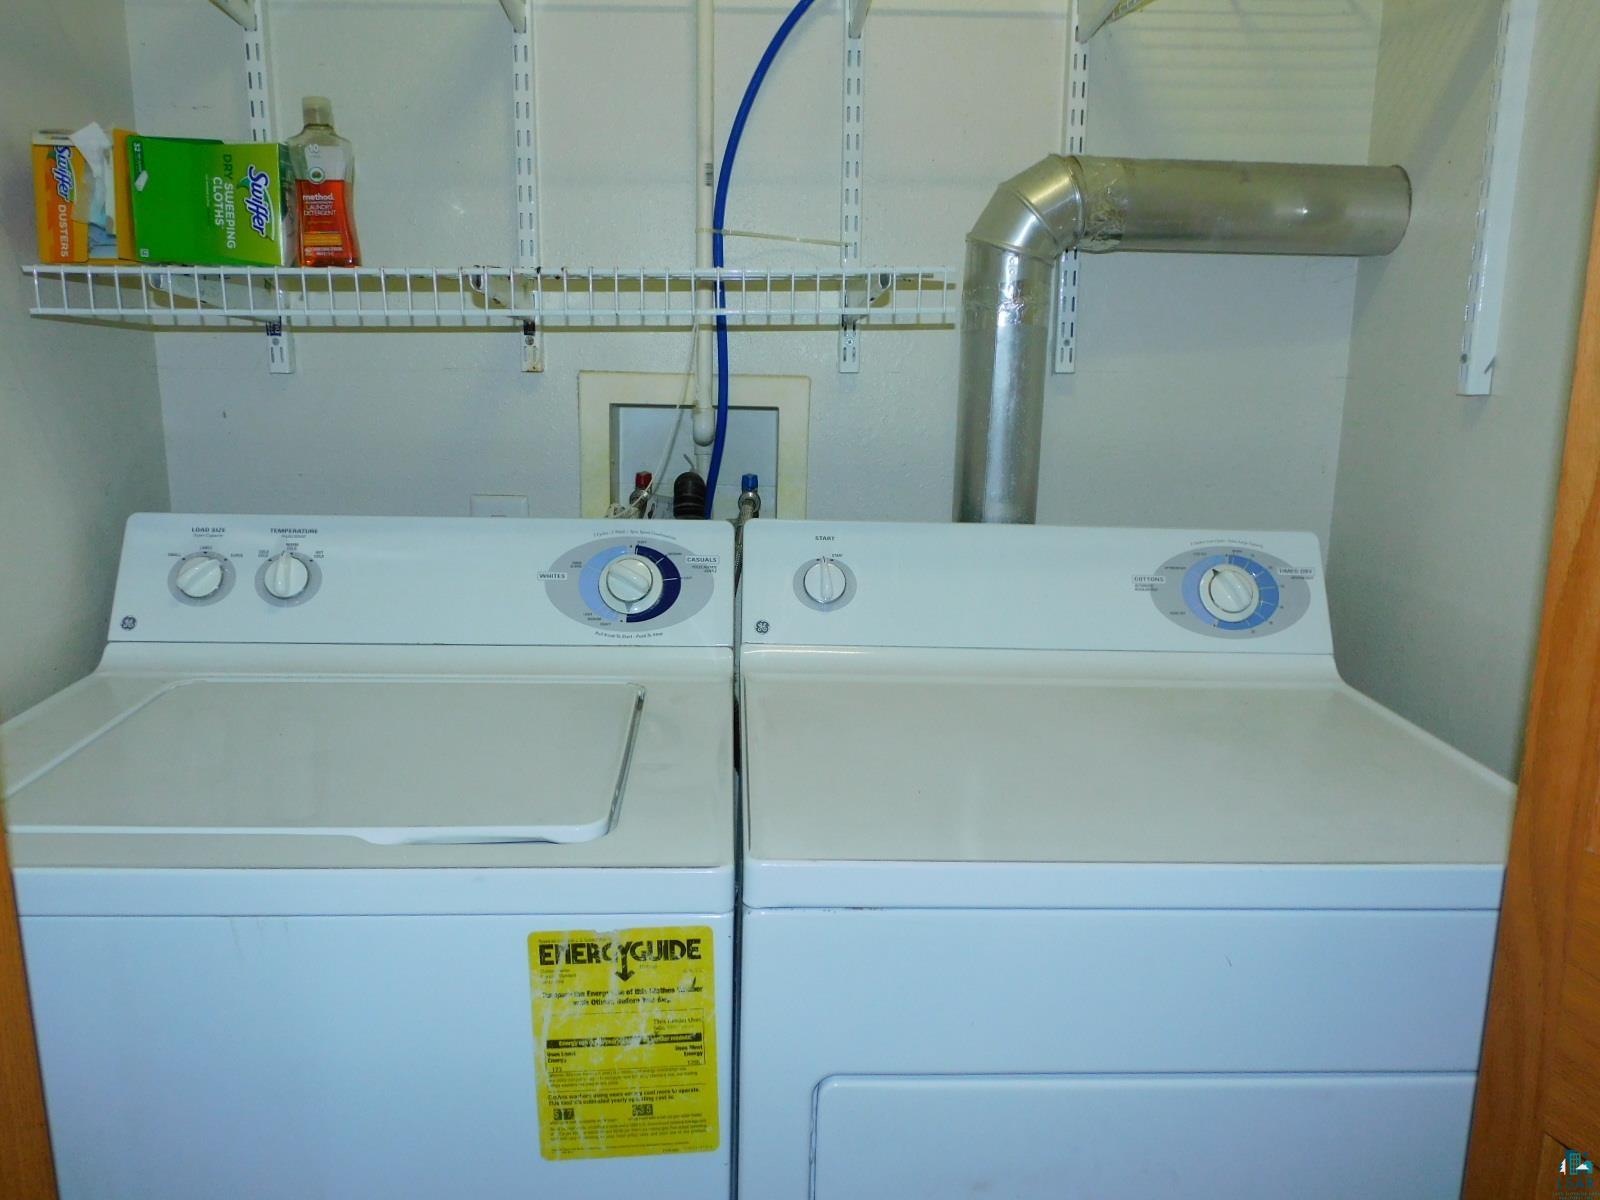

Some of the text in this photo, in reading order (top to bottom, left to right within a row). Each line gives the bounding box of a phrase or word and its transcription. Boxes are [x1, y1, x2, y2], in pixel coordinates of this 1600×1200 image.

[52, 145, 72, 257] Swiffer DUSTERS
[213, 176, 224, 226] CLOTHS
[223, 153, 236, 249] DRY SWEEPING
[244, 164, 270, 237] Swiffer
[538, 938, 702, 966] ENERGYGUIDE
